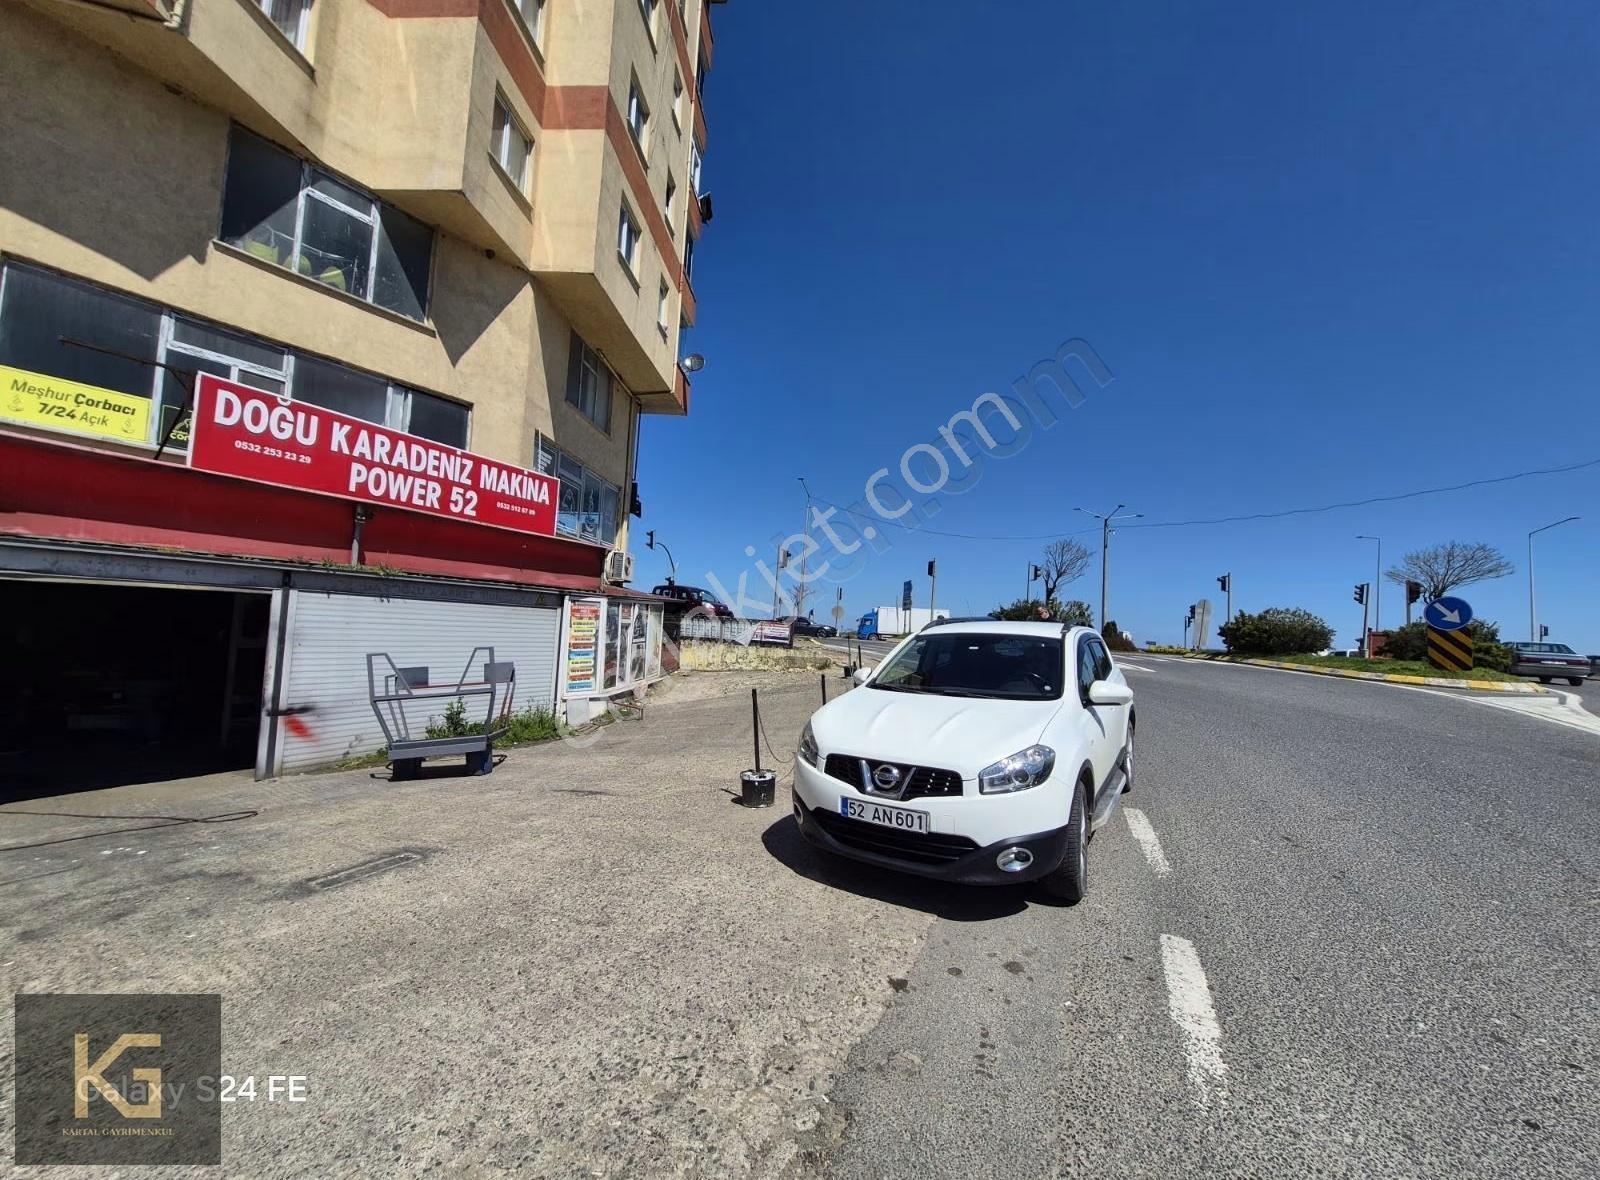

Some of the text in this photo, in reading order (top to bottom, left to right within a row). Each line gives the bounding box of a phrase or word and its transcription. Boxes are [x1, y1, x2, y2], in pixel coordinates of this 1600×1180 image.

[10, 379, 136, 415] Meşhur Çorbacı
[38, 402, 109, 427] 7/24 Açık
[214, 388, 319, 446] DOĞU
[330, 421, 473, 485] KARADENİZ
[479, 463, 550, 505] MAKİNA
[234, 440, 312, 464] 0532 253 23 29
[348, 463, 479, 516] POWER 52
[848, 801, 865, 819] 52
